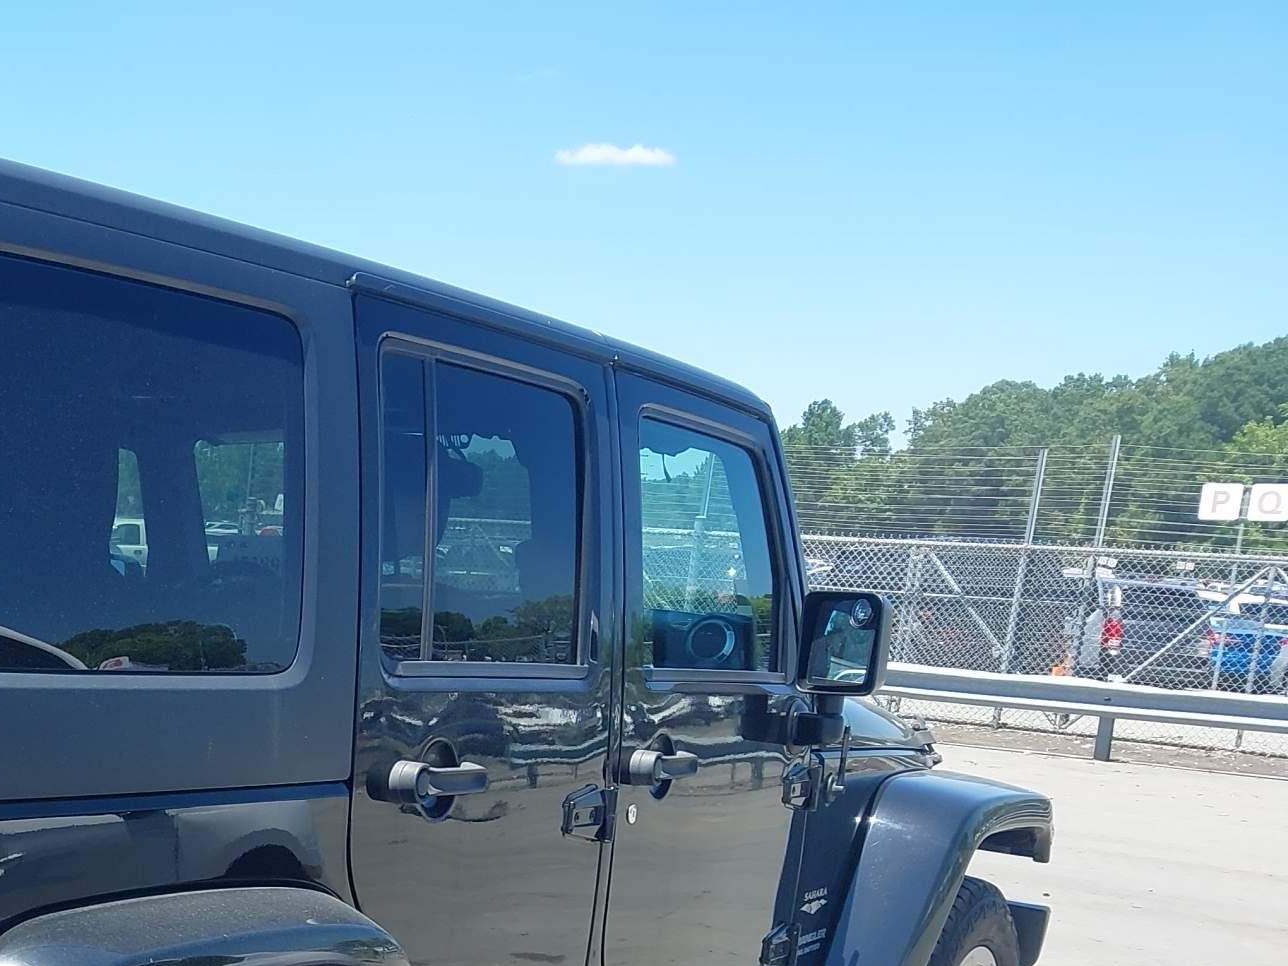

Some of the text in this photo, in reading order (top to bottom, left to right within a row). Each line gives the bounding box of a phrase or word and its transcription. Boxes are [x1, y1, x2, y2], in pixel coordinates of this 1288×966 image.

[1211, 490, 1231, 513] P
[1257, 490, 1283, 515] Q
[804, 888, 827, 901] SAHARA
